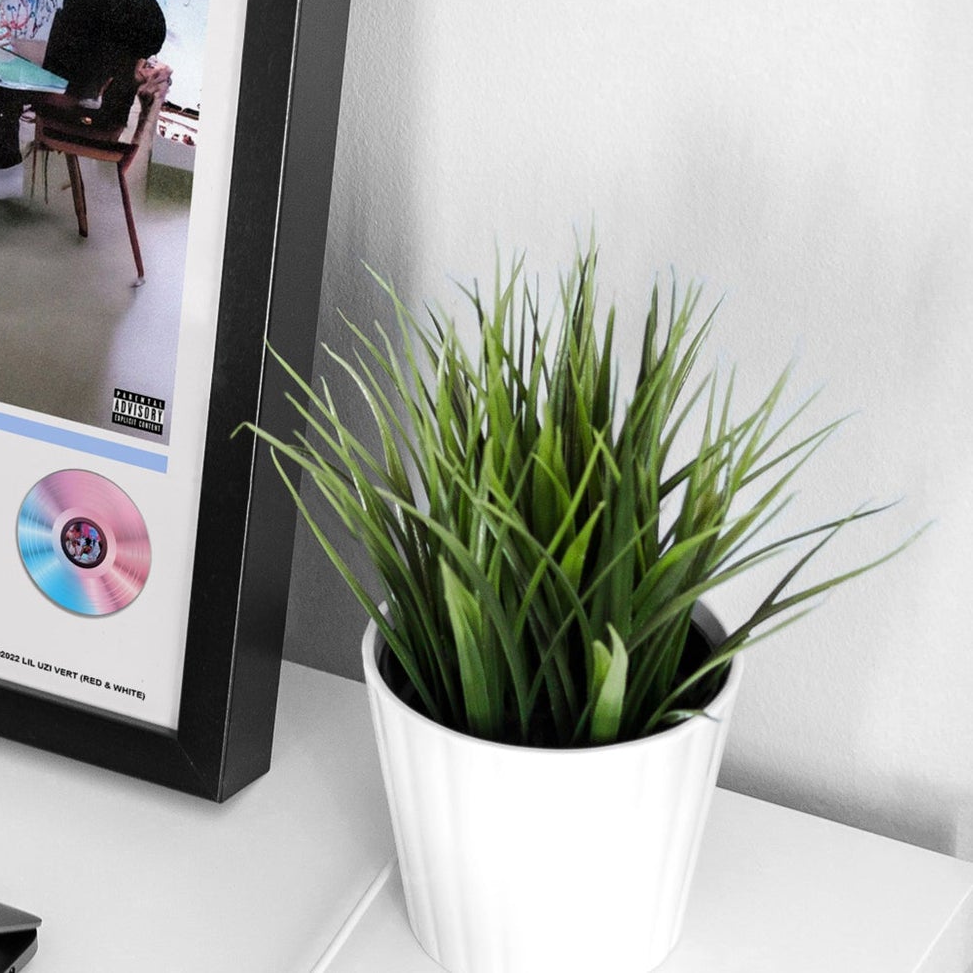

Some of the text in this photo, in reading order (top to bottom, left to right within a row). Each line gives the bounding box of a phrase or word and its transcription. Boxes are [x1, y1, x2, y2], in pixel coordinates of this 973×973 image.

[114, 399, 163, 423] ADVISORY
[116, 390, 163, 409] PARENTAL
[22, 657, 35, 667] LIL
[37, 662, 52, 672] UZI
[54, 666, 78, 679] VERT
[80, 674, 102, 687] (RED
[113, 684, 145, 701] WHITE)
